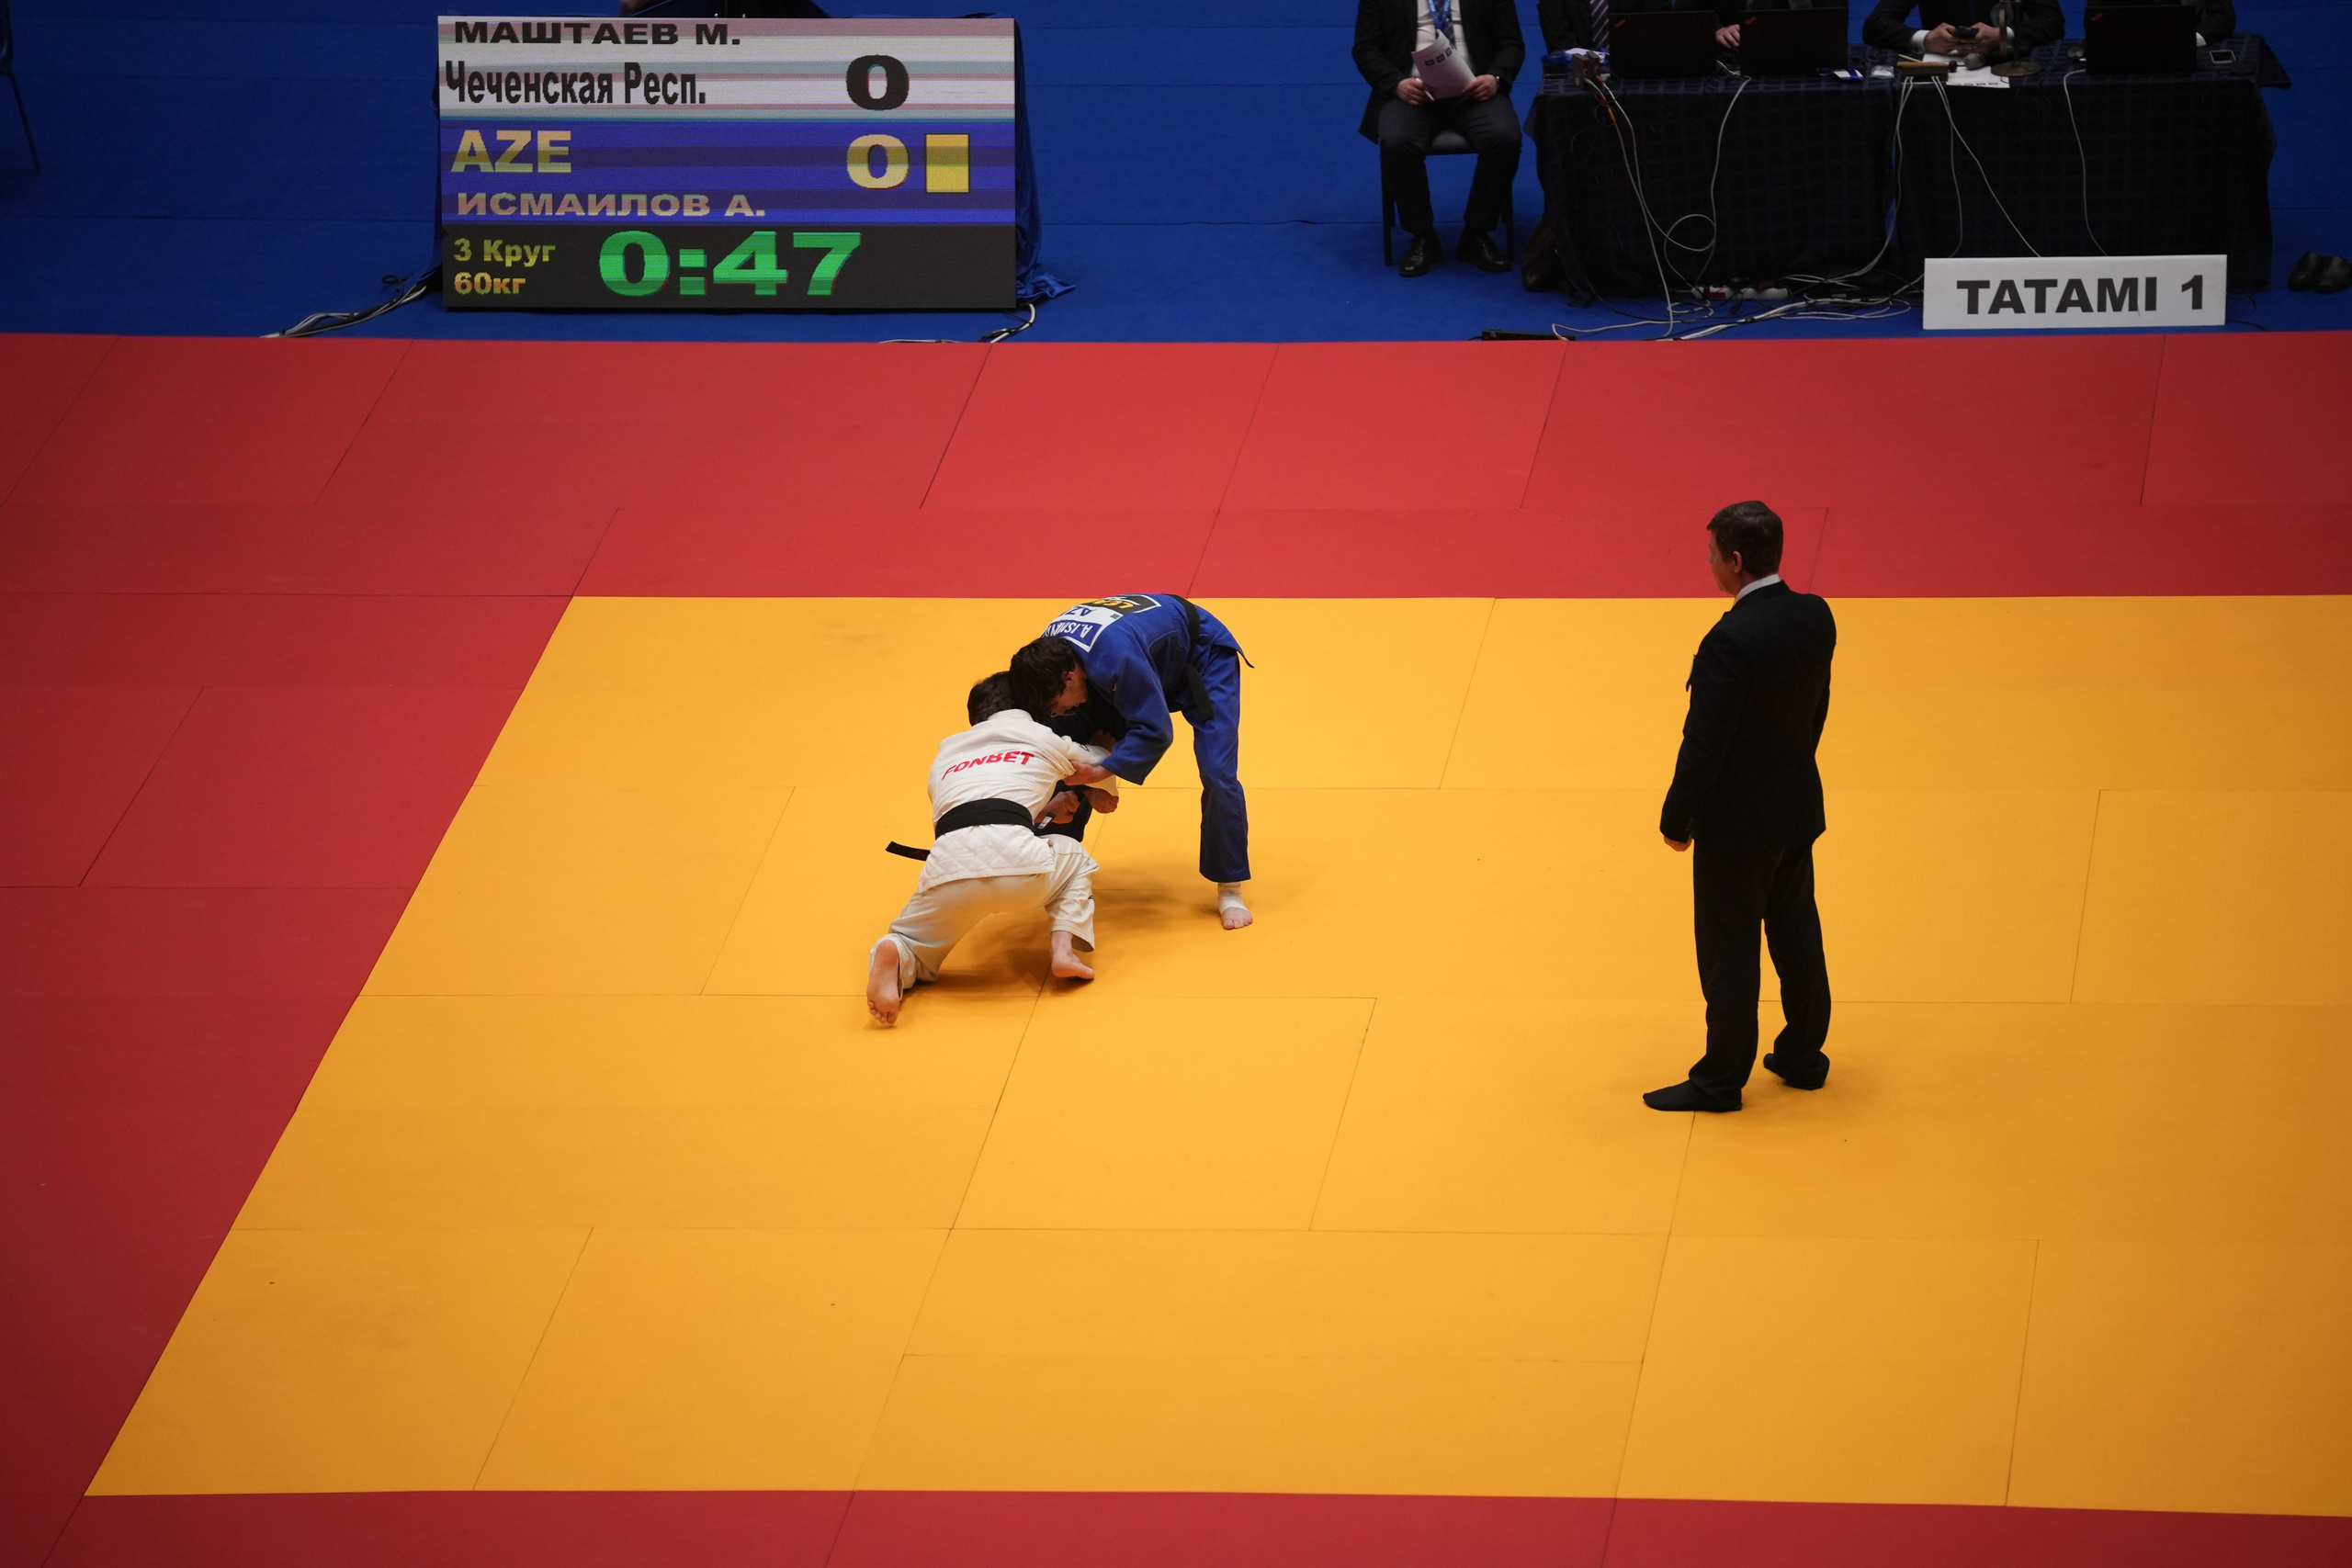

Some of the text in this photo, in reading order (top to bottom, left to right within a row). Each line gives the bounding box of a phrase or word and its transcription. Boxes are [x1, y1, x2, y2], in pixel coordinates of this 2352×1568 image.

[455, 21, 741, 45] МАШТАЕВ М.
[446, 61, 706, 105] Чеченская Респ.
[846, 54, 910, 110] 0
[450, 130, 571, 173] AZE
[846, 134, 910, 190] 0
[458, 192, 765, 217] ИСМАИЛОВ А.
[454, 238, 556, 267] 3 Круг
[599, 231, 862, 297] 0:47
[454, 272, 526, 295] 60кг
[1956, 275, 2203, 314] TATAMI 1
[941, 750, 1035, 781] FONBET
